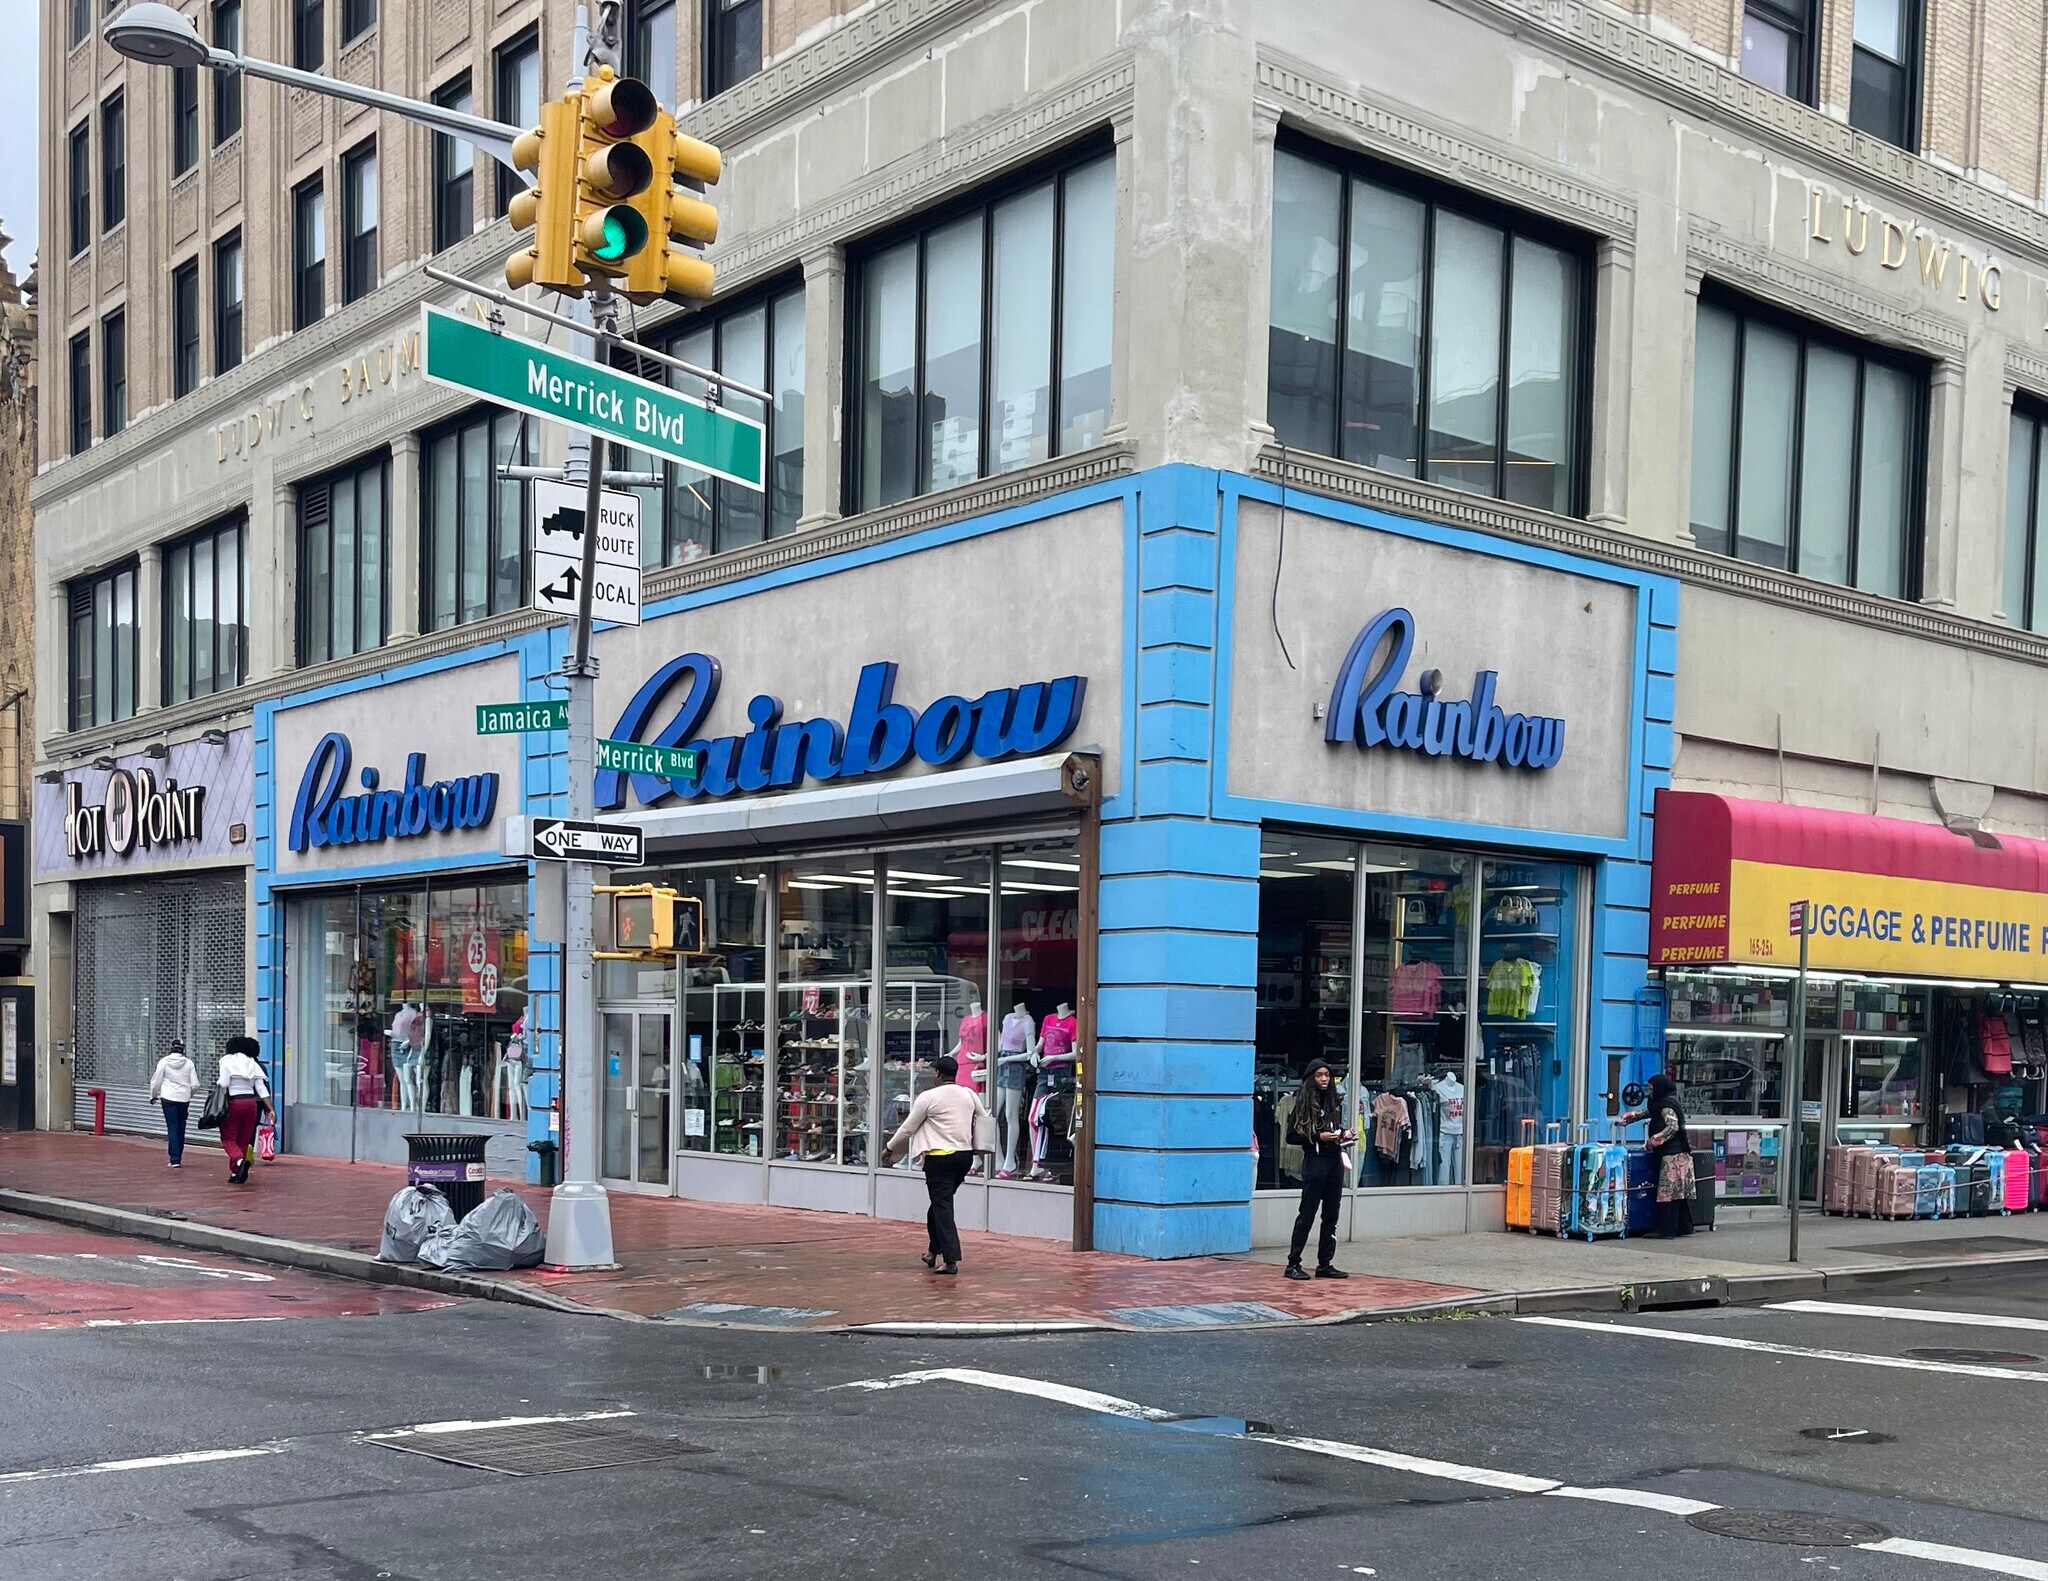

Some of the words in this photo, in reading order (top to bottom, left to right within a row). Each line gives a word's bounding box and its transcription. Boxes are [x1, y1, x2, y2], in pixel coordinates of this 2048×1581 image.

[1811, 189, 2001, 311] LUDWIG
[528, 359, 624, 425] Merrick
[635, 396, 684, 446] Blvd
[216, 387, 315, 463] LUDWIG
[600, 508, 634, 529] RUCK
[592, 582, 636, 606] OCAL
[1325, 606, 1566, 769] Rainbow
[480, 705, 551, 732] Jamaica
[594, 652, 1087, 808] Rainbow
[598, 744, 664, 773] Merrick
[670, 753, 694, 769] Blvd
[289, 732, 499, 851] Rainbow
[65, 782, 105, 856] HOT
[545, 831, 582, 848] ONE
[601, 836, 634, 851] WAY
[1669, 882, 1721, 895] PERFUME
[1663, 914, 1727, 930] PERFUME
[1807, 904, 1902, 941] UGGAGE
[1911, 913, 1926, 944] &
[1931, 915, 2030, 953] PERFUME
[470, 943, 483, 965] 25
[1661, 946, 1726, 961] PERFUME
